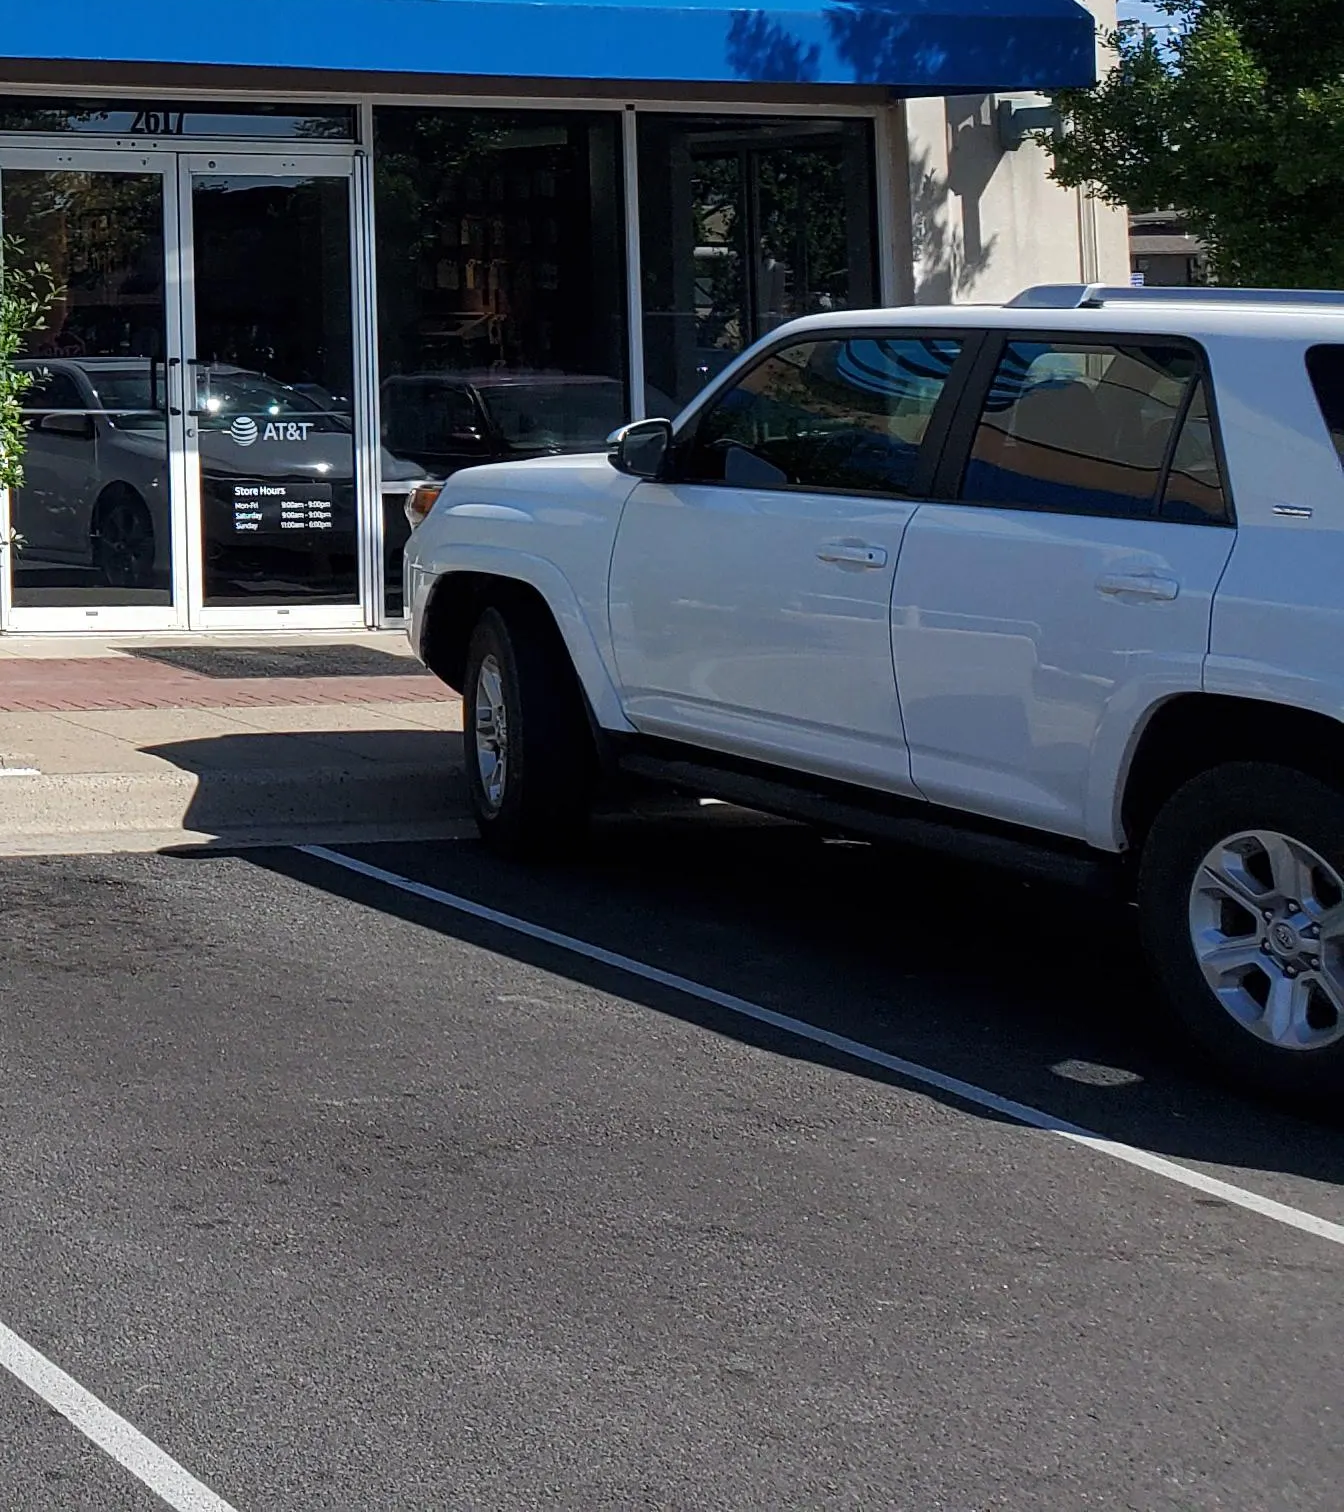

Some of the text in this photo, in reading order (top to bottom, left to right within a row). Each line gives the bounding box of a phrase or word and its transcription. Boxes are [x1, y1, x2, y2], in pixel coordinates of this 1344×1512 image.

[130, 107, 184, 135] 2617
[263, 422, 314, 441] AT&T
[234, 486, 286, 497] Store Hours
[235, 512, 263, 521] Saturday
[235, 522, 259, 531] Sunday
